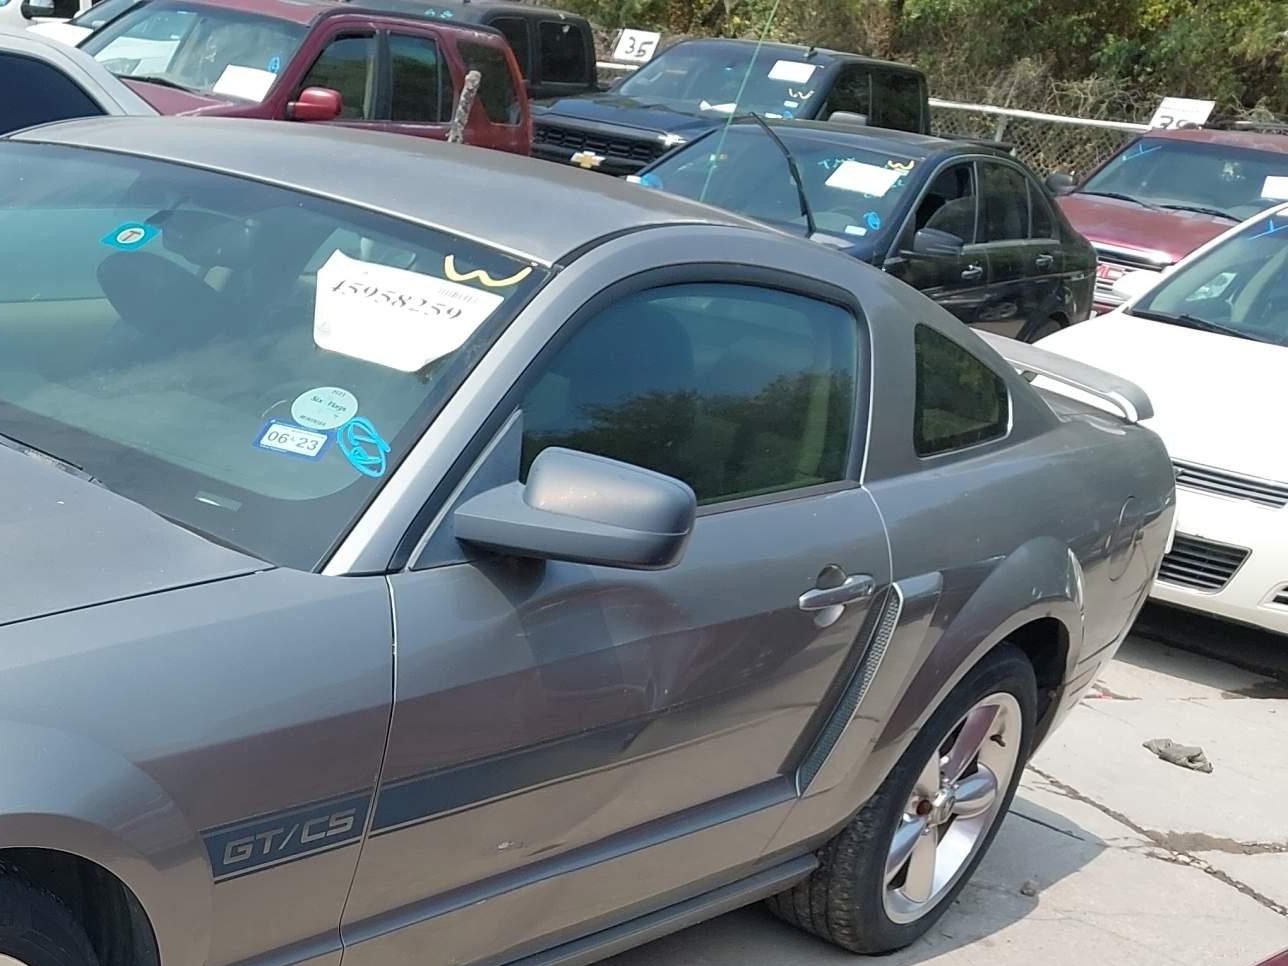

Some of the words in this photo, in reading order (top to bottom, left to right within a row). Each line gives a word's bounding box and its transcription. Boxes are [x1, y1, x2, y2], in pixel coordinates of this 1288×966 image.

[330, 278, 463, 320] 45958259
[267, 430, 290, 444] 06
[295, 436, 319, 451] 23
[223, 808, 357, 865] GT/CS
